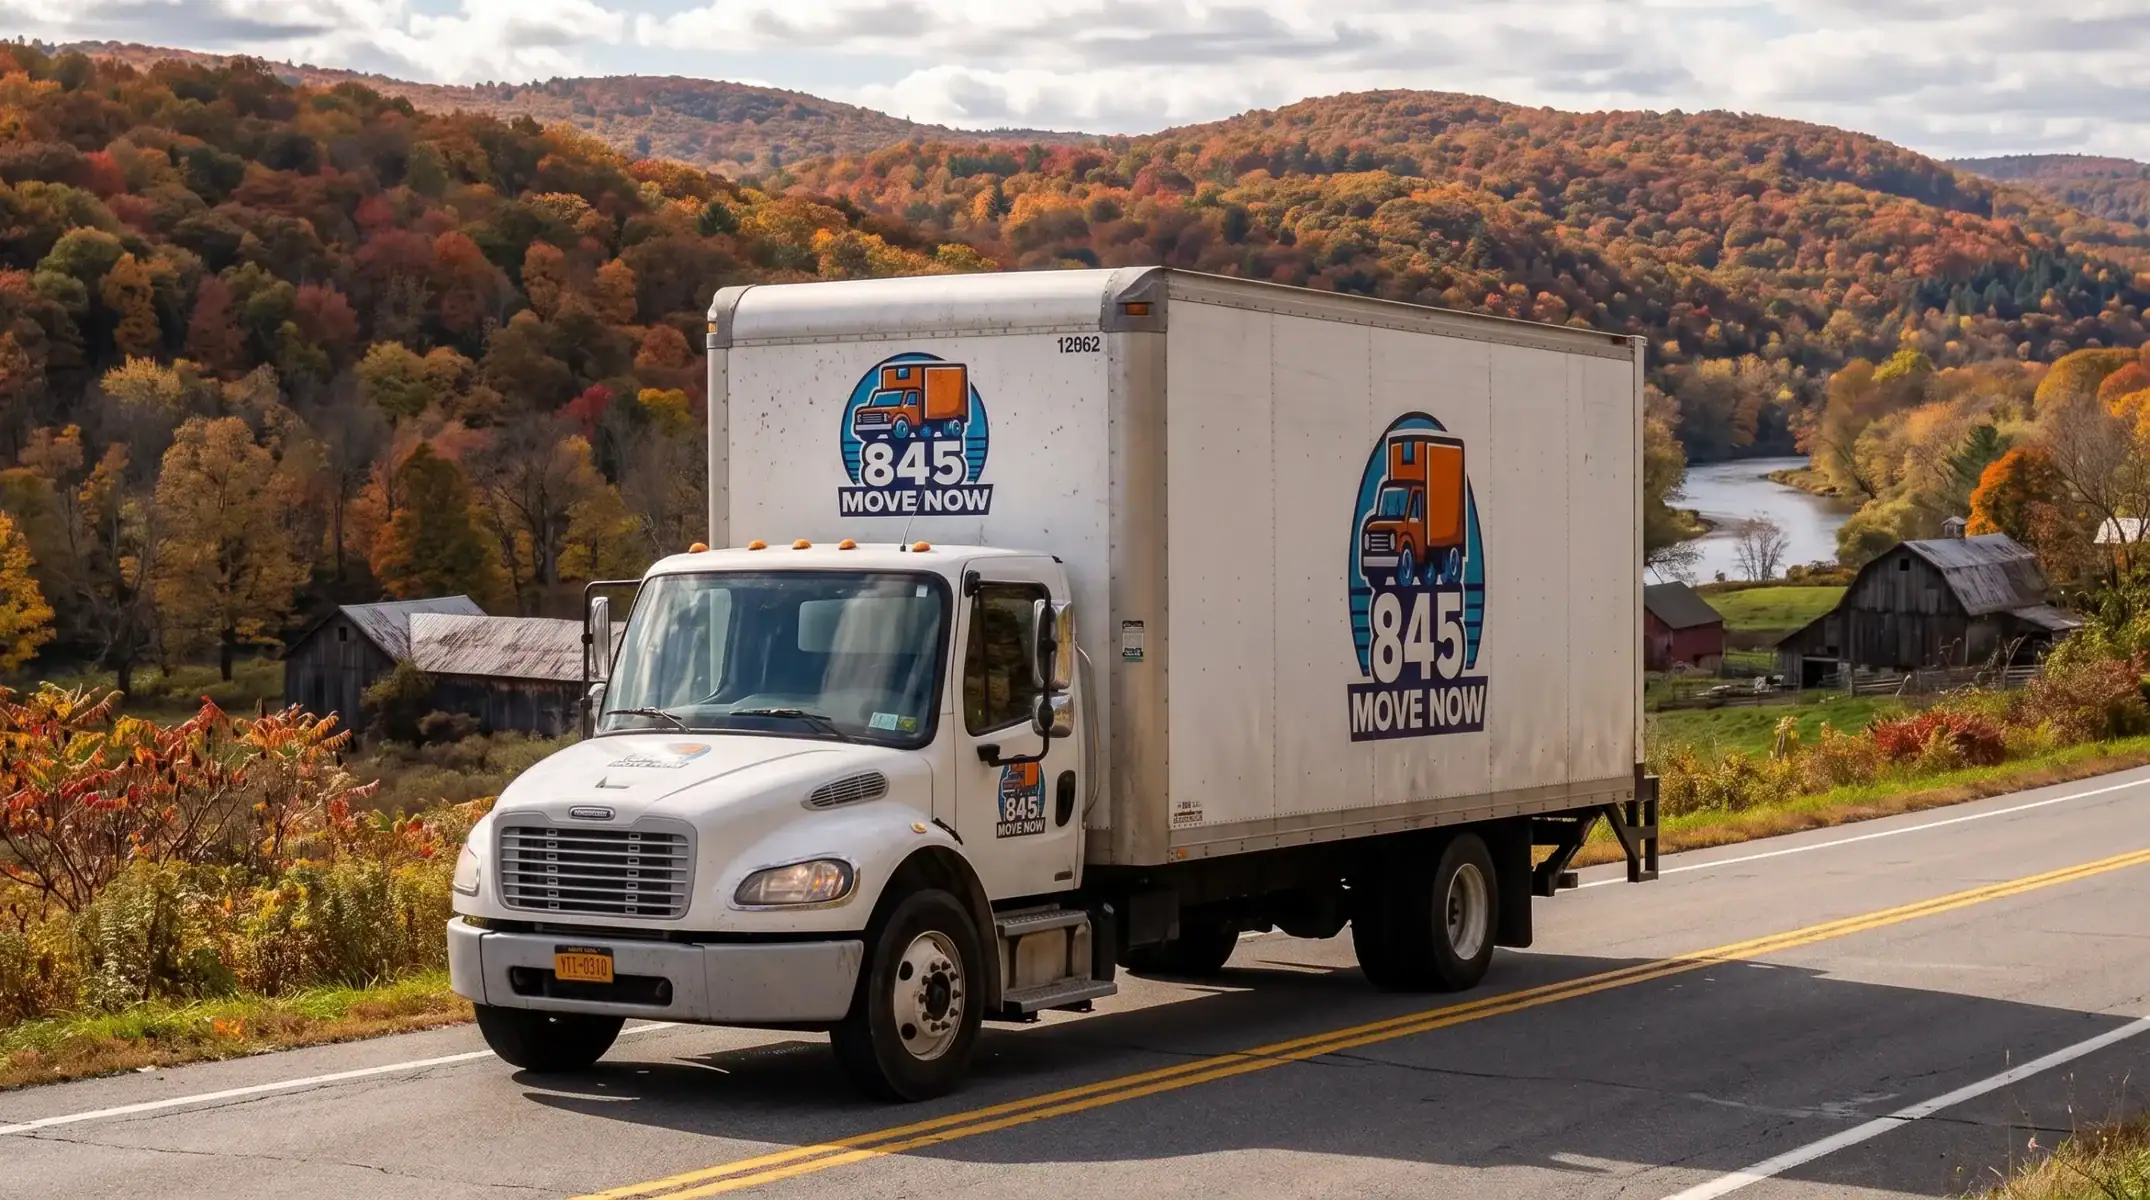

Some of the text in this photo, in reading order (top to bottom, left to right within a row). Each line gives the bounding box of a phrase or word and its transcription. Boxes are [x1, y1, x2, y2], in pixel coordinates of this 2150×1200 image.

[864, 440, 963, 487] 845
[842, 488, 990, 513] MOVE NOW
[1372, 592, 1463, 684] 845
[1352, 685, 1485, 733] MOVE NOW
[1006, 796, 1038, 821] 845
[998, 819, 1044, 836] MOVE NOW
